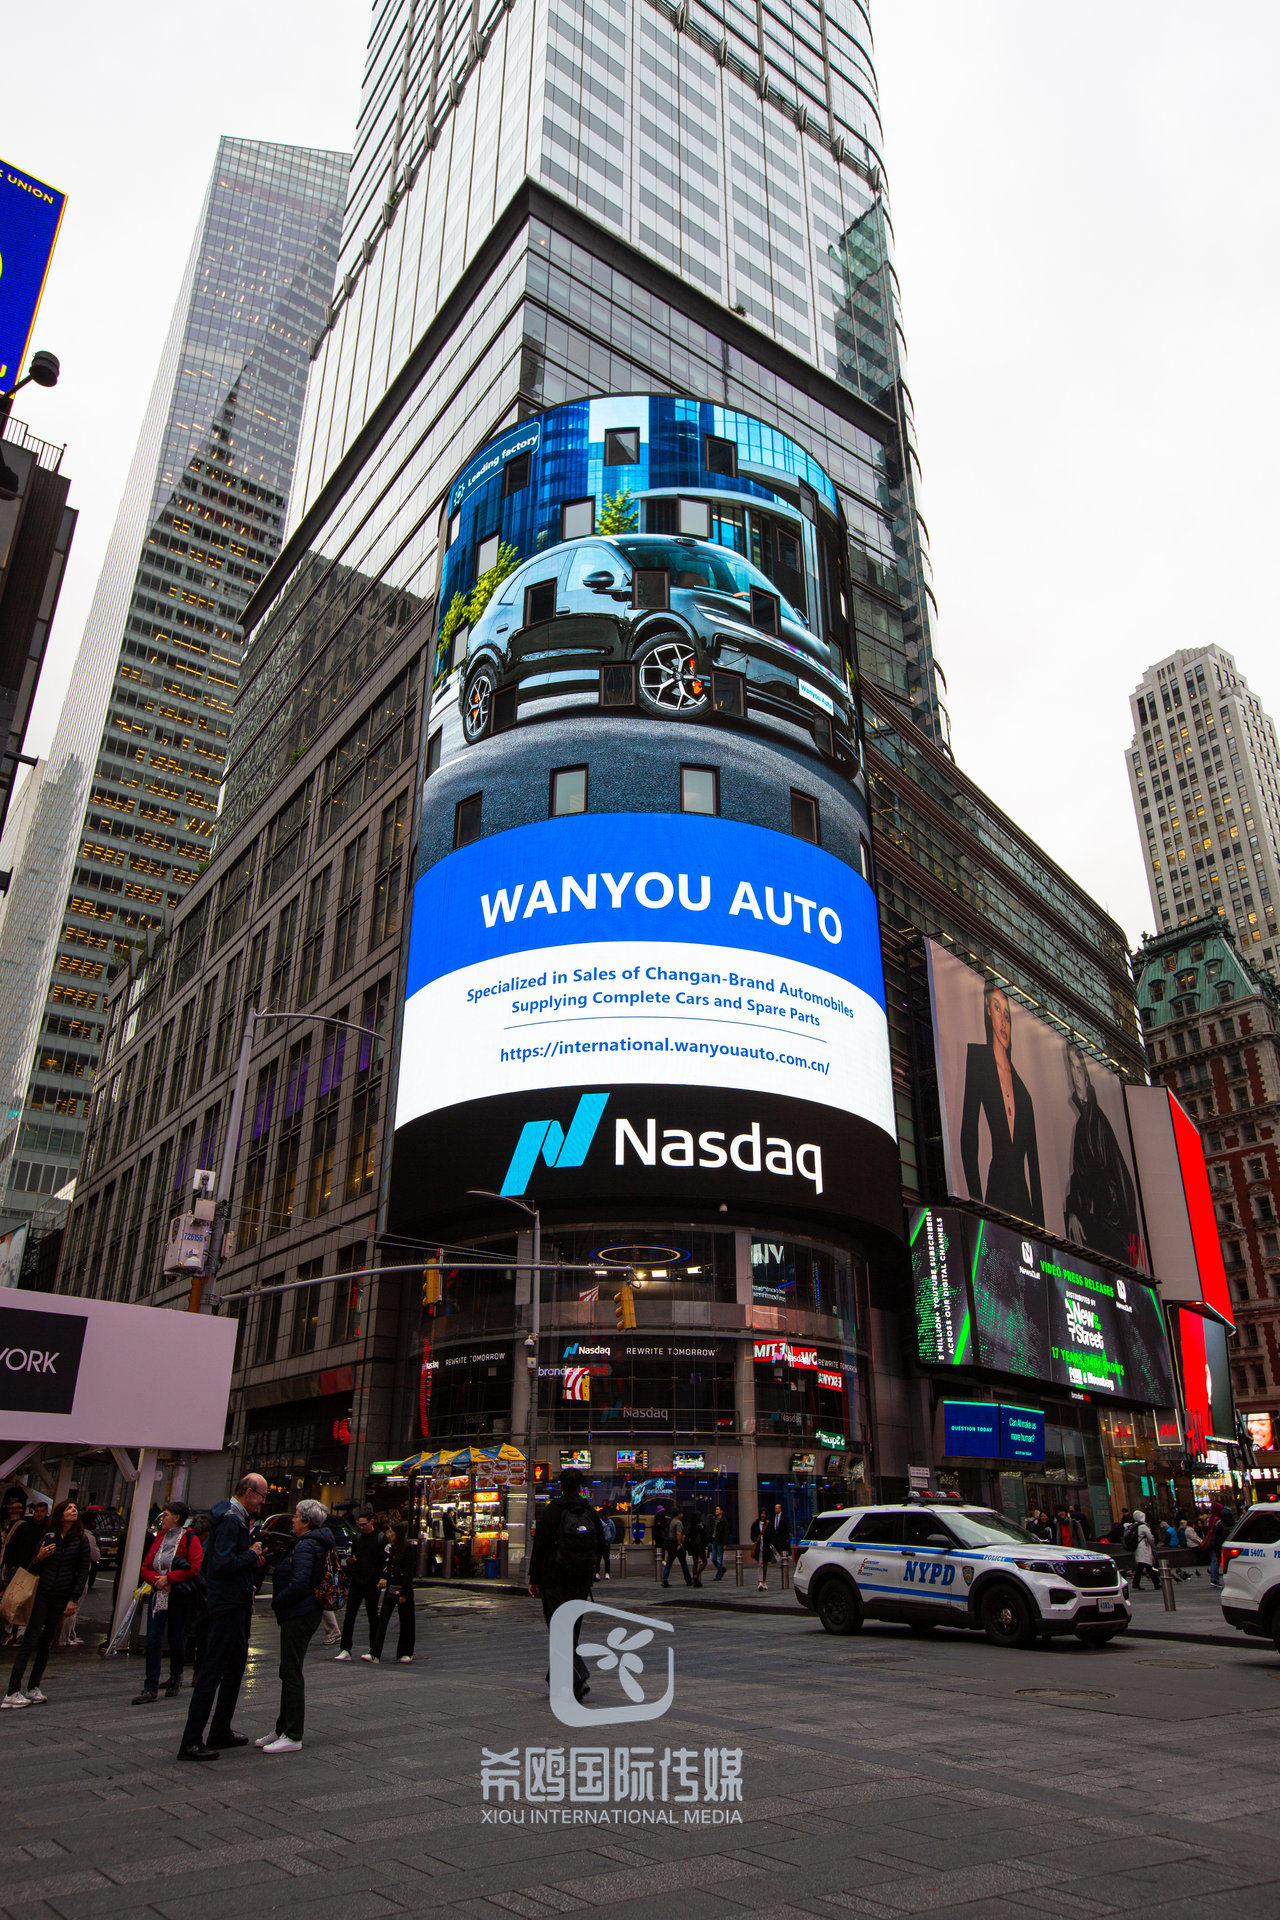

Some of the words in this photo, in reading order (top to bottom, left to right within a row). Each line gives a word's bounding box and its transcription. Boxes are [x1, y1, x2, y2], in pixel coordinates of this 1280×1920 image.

[7, 173, 54, 204] UNION
[468, 456, 500, 487] Leading
[502, 435, 539, 459] factory
[480, 871, 711, 929] WANYOU
[728, 881, 843, 945] AUTO
[467, 972, 547, 1004] Specialized
[553, 971, 568, 985] in
[573, 967, 617, 983] Sales
[622, 966, 641, 980] of
[646, 967, 775, 993] Changan-Brand
[780, 982, 854, 1019] Automobiles
[512, 993, 588, 1015] Supplying
[593, 990, 671, 1007] Complete
[675, 992, 710, 1007] Cars
[713, 994, 742, 1010] and
[746, 998, 786, 1021] Spare
[790, 1008, 821, 1027] Parts
[501, 1037, 831, 1076] https://international.wanyouauto.com.cn/
[615, 1119, 824, 1195] Nasdaq
[926, 1211, 937, 1267] SUBSCRIBERS
[936, 1217, 946, 1261] CHANNELS
[930, 1269, 940, 1309] YOUTUBE
[941, 1263, 950, 1297] DIGITAL
[1040, 1259, 1062, 1278] VIDEO
[1063, 1268, 1084, 1287] PRESS
[1084, 1276, 1115, 1298] RELEASES
[944, 1300, 952, 1318] OUR
[1072, 1300, 1095, 1329] New
[578, 1345, 612, 1356] Nasdaq
[626, 1347, 664, 1355] REWRITE
[668, 1347, 716, 1357] TOMORROW
[946, 1320, 955, 1355] ACROSS
[1076, 1323, 1105, 1350] Street
[445, 1357, 467, 1367] REWRITE
[469, 1352, 506, 1364] TOMORROW
[1051, 1346, 1059, 1359] 17
[1060, 1348, 1083, 1365] YEARS
[623, 1407, 668, 1421] Nasdaq
[903, 1560, 956, 1586] NYPD
[984, 1554, 1006, 1562] POLICE
